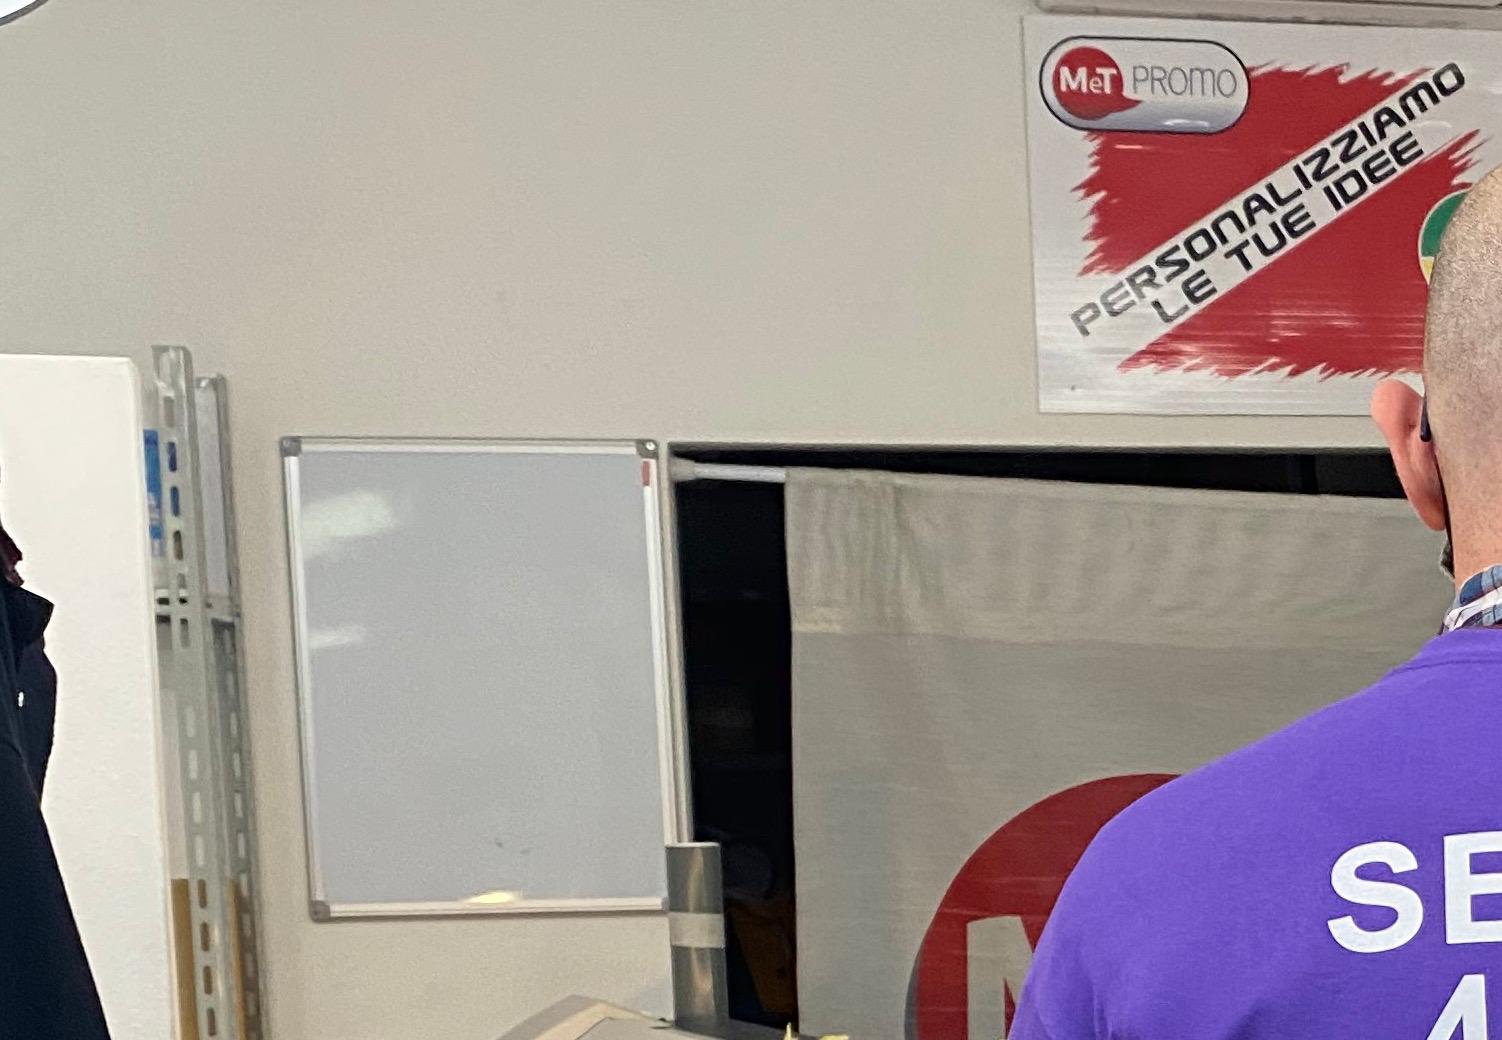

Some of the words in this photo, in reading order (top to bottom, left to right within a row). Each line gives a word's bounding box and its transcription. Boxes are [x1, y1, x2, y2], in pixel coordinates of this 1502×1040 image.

[1059, 66, 1118, 95] MeT
[1131, 65, 1238, 99] PROMO
[1070, 61, 1466, 337] PERSONALIZZIAMO
[1150, 270, 1218, 324] LE
[1223, 202, 1317, 272] TUE
[1322, 130, 1425, 212] IDEE
